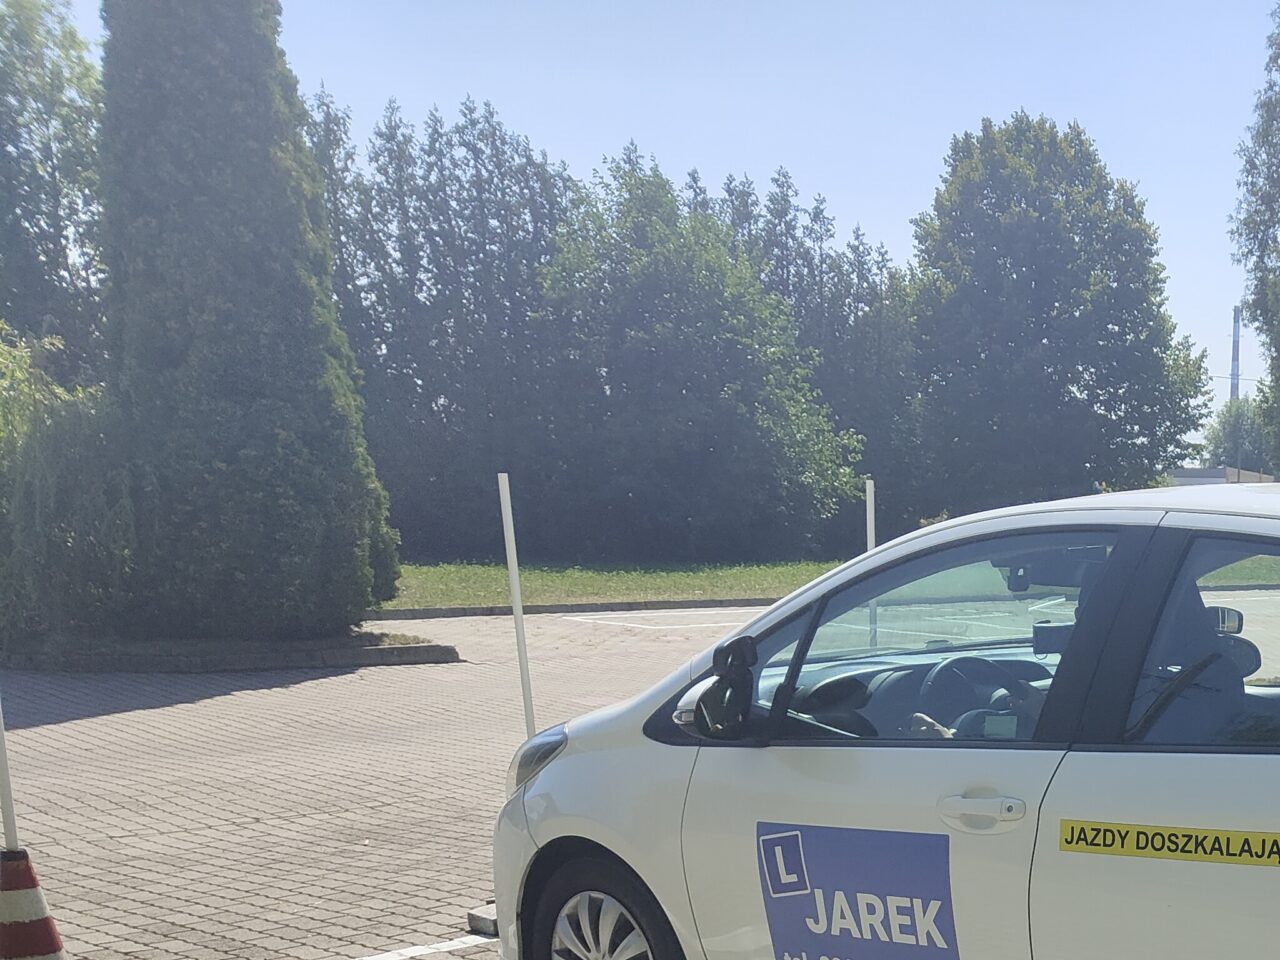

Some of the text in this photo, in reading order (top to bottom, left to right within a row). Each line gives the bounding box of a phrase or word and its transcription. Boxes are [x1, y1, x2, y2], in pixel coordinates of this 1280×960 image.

[1064, 826, 1130, 849] JAZDY
[773, 845, 799, 884] L
[805, 888, 949, 950] JAREK
